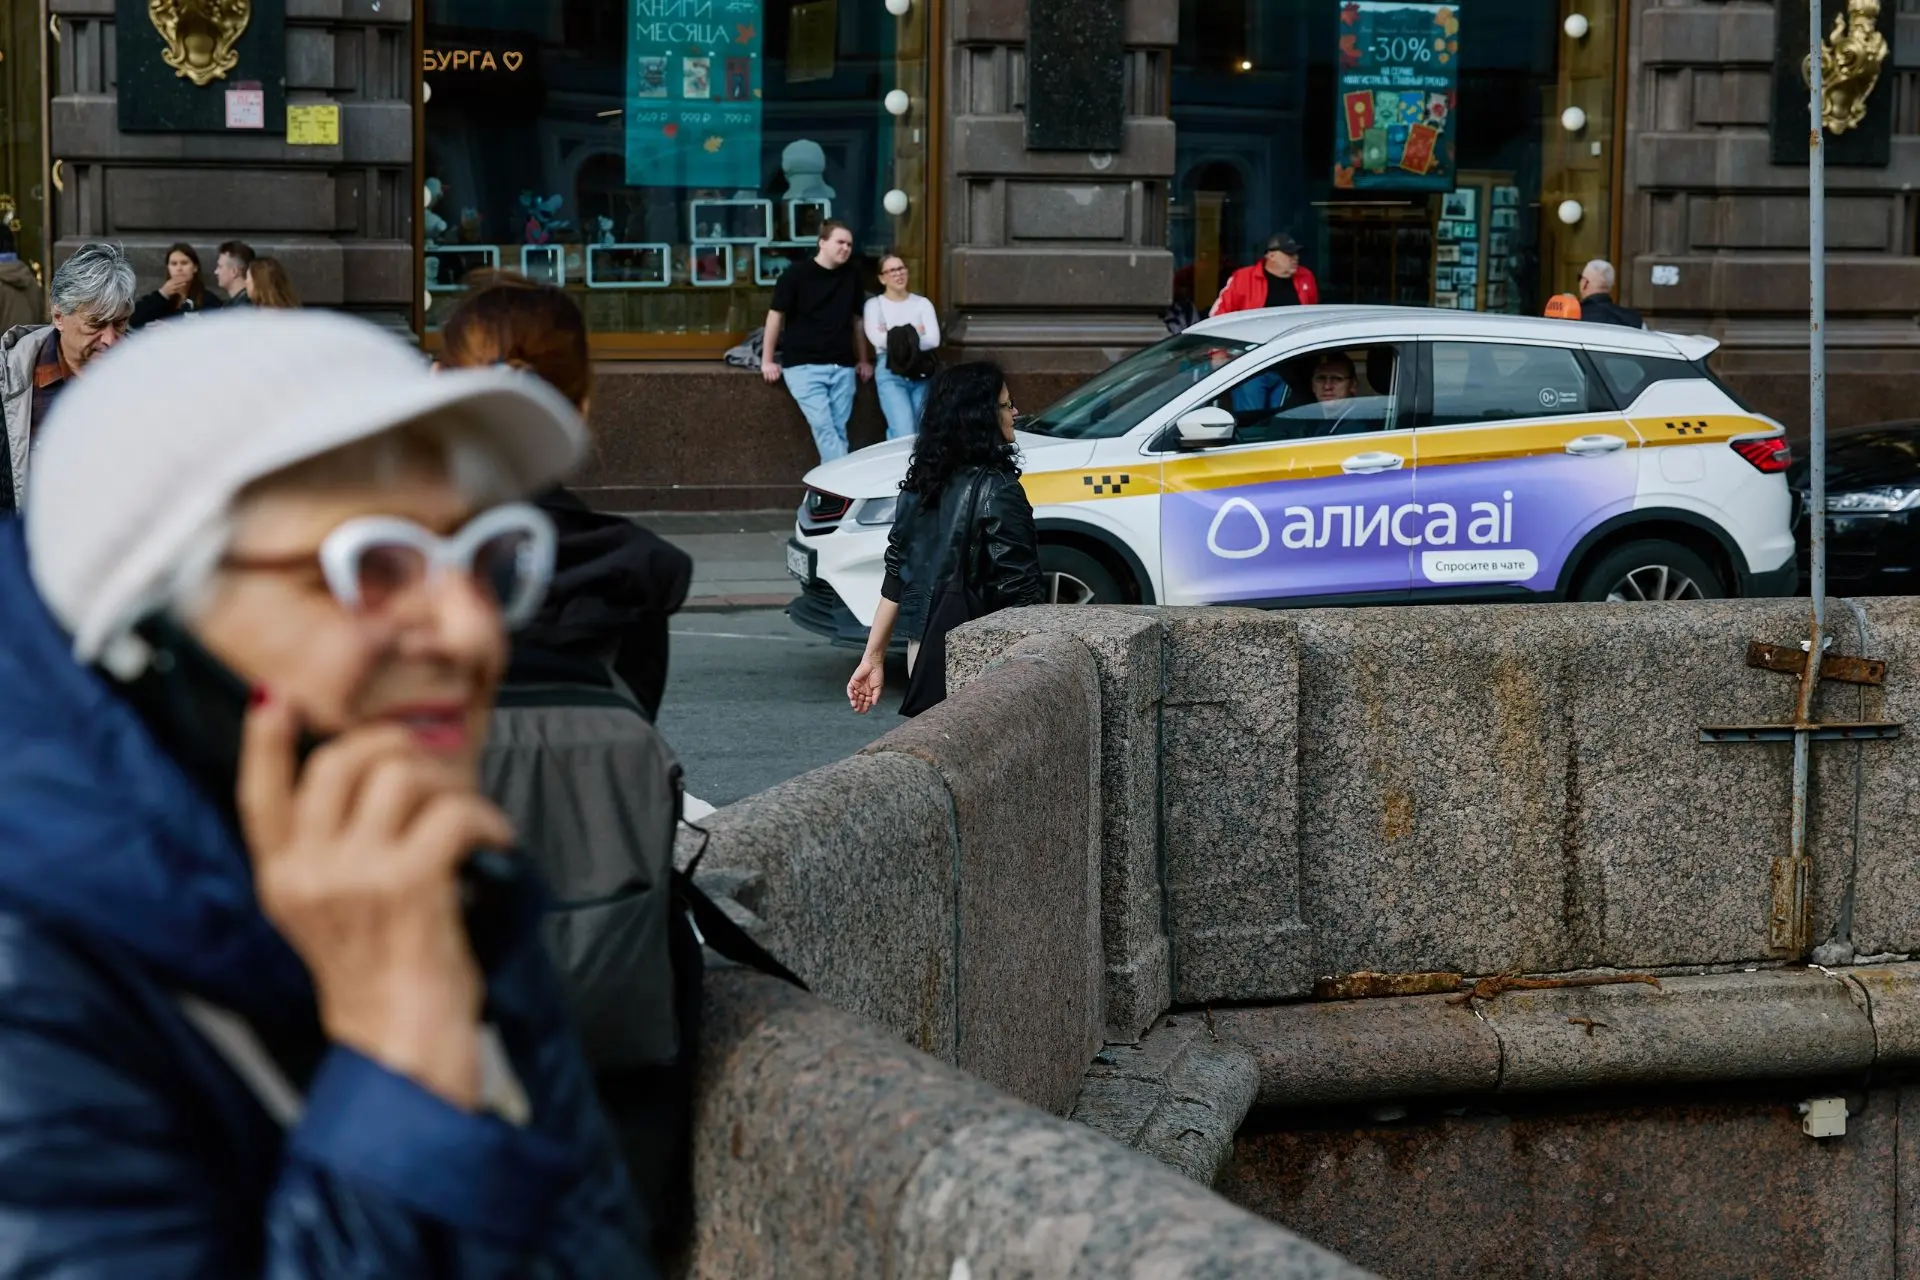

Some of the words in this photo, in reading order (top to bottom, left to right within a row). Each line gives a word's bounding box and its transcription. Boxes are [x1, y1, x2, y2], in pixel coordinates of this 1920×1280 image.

[636, 0, 713, 18] КНИГИ
[636, 22, 730, 44] МЕСЯЦА
[1368, 37, 1431, 62] -30%
[1281, 503, 1457, 549] алиса
[1435, 561, 1489, 572] Спросите
[1491, 562, 1498, 570] в
[1500, 561, 1525, 570] чате
